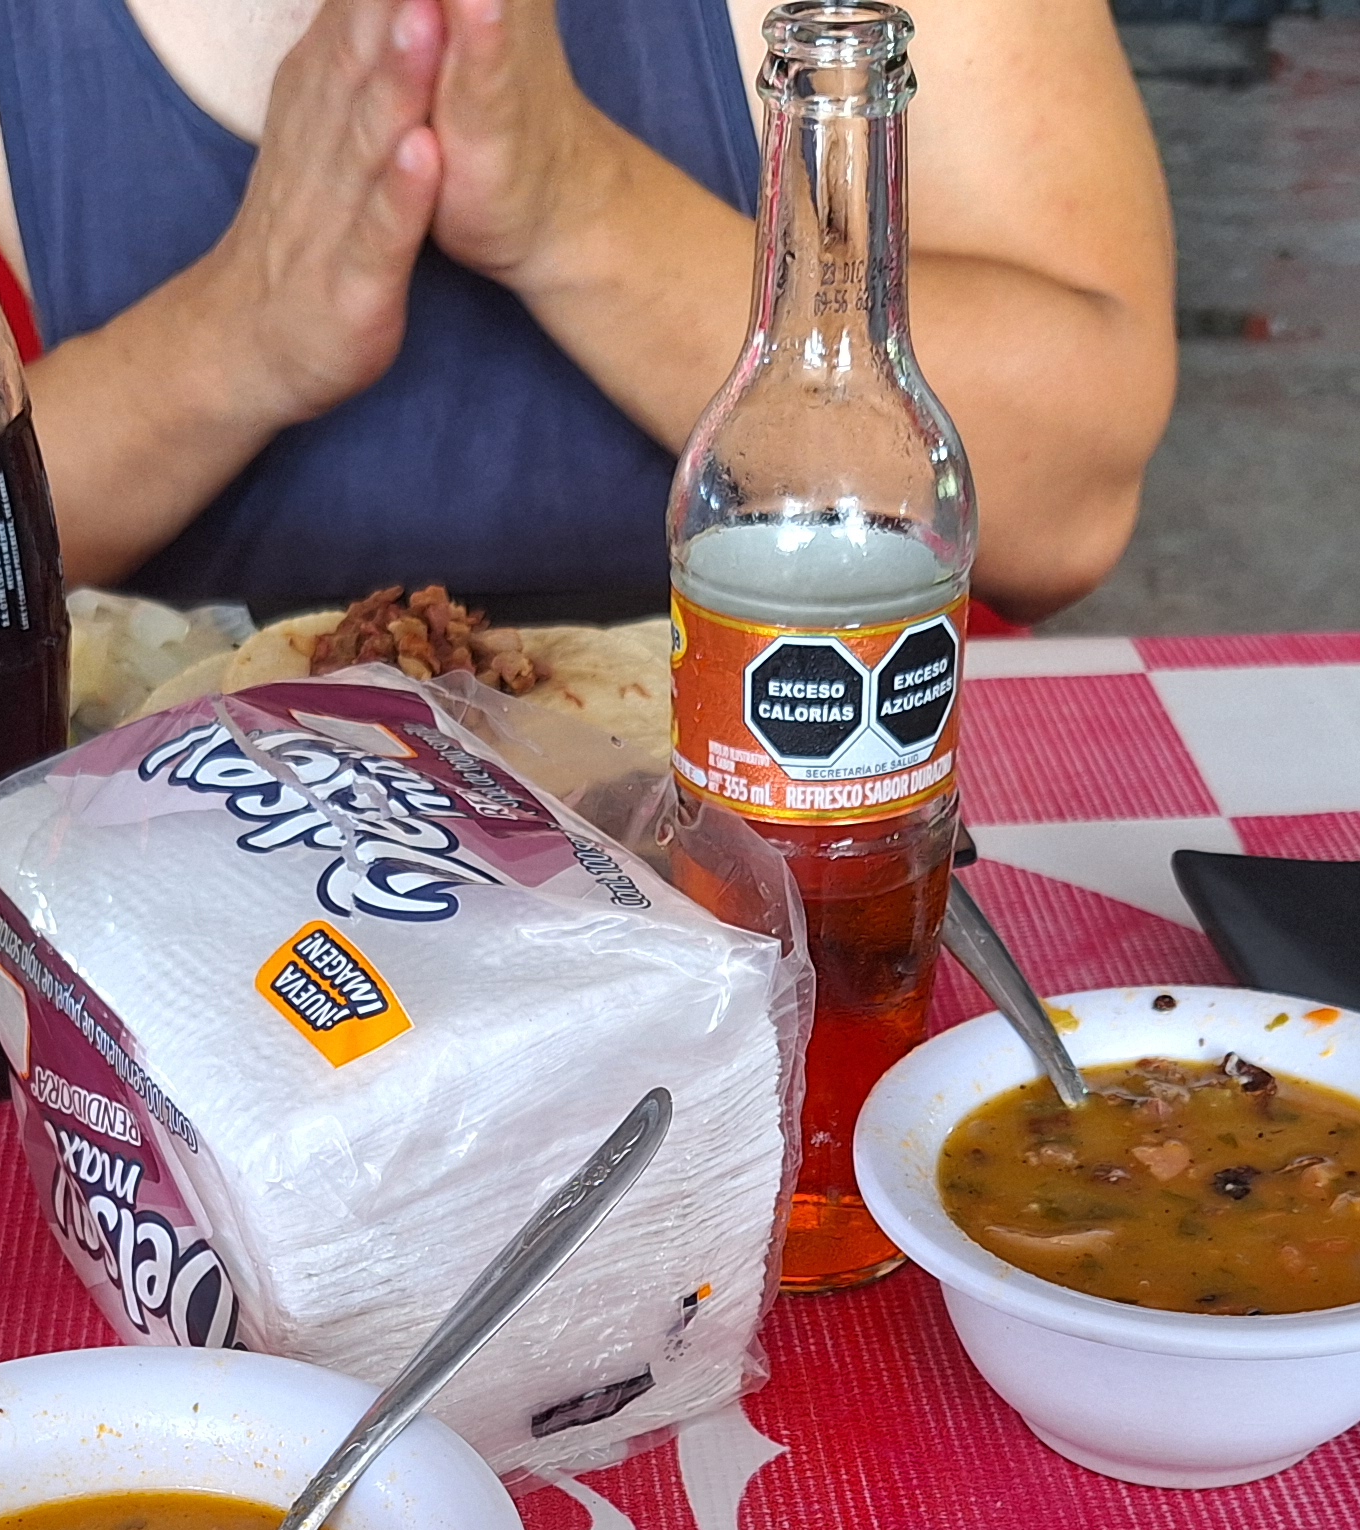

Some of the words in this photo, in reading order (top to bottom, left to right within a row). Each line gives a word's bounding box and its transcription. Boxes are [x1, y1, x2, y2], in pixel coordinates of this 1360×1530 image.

[768, 679, 845, 699] EXCESO
[893, 658, 949, 691] EXCESO
[758, 702, 855, 723] CALORÍAS
[880, 677, 953, 718] AZÚCARES
[805, 762, 872, 779] SECRETARÍA
[875, 761, 889, 774] DE
[890, 753, 919, 772] SALUD
[723, 774, 748, 801] 355
[750, 780, 775, 807] mL
[785, 782, 865, 809] REFRESCO
[865, 773, 909, 805] SABOR
[297, 932, 384, 1015] IMAGEN!
[274, 965, 351, 1027] ¡NUEVA
[144, 1076, 165, 1125] 100
[59, 1130, 141, 1205] max
